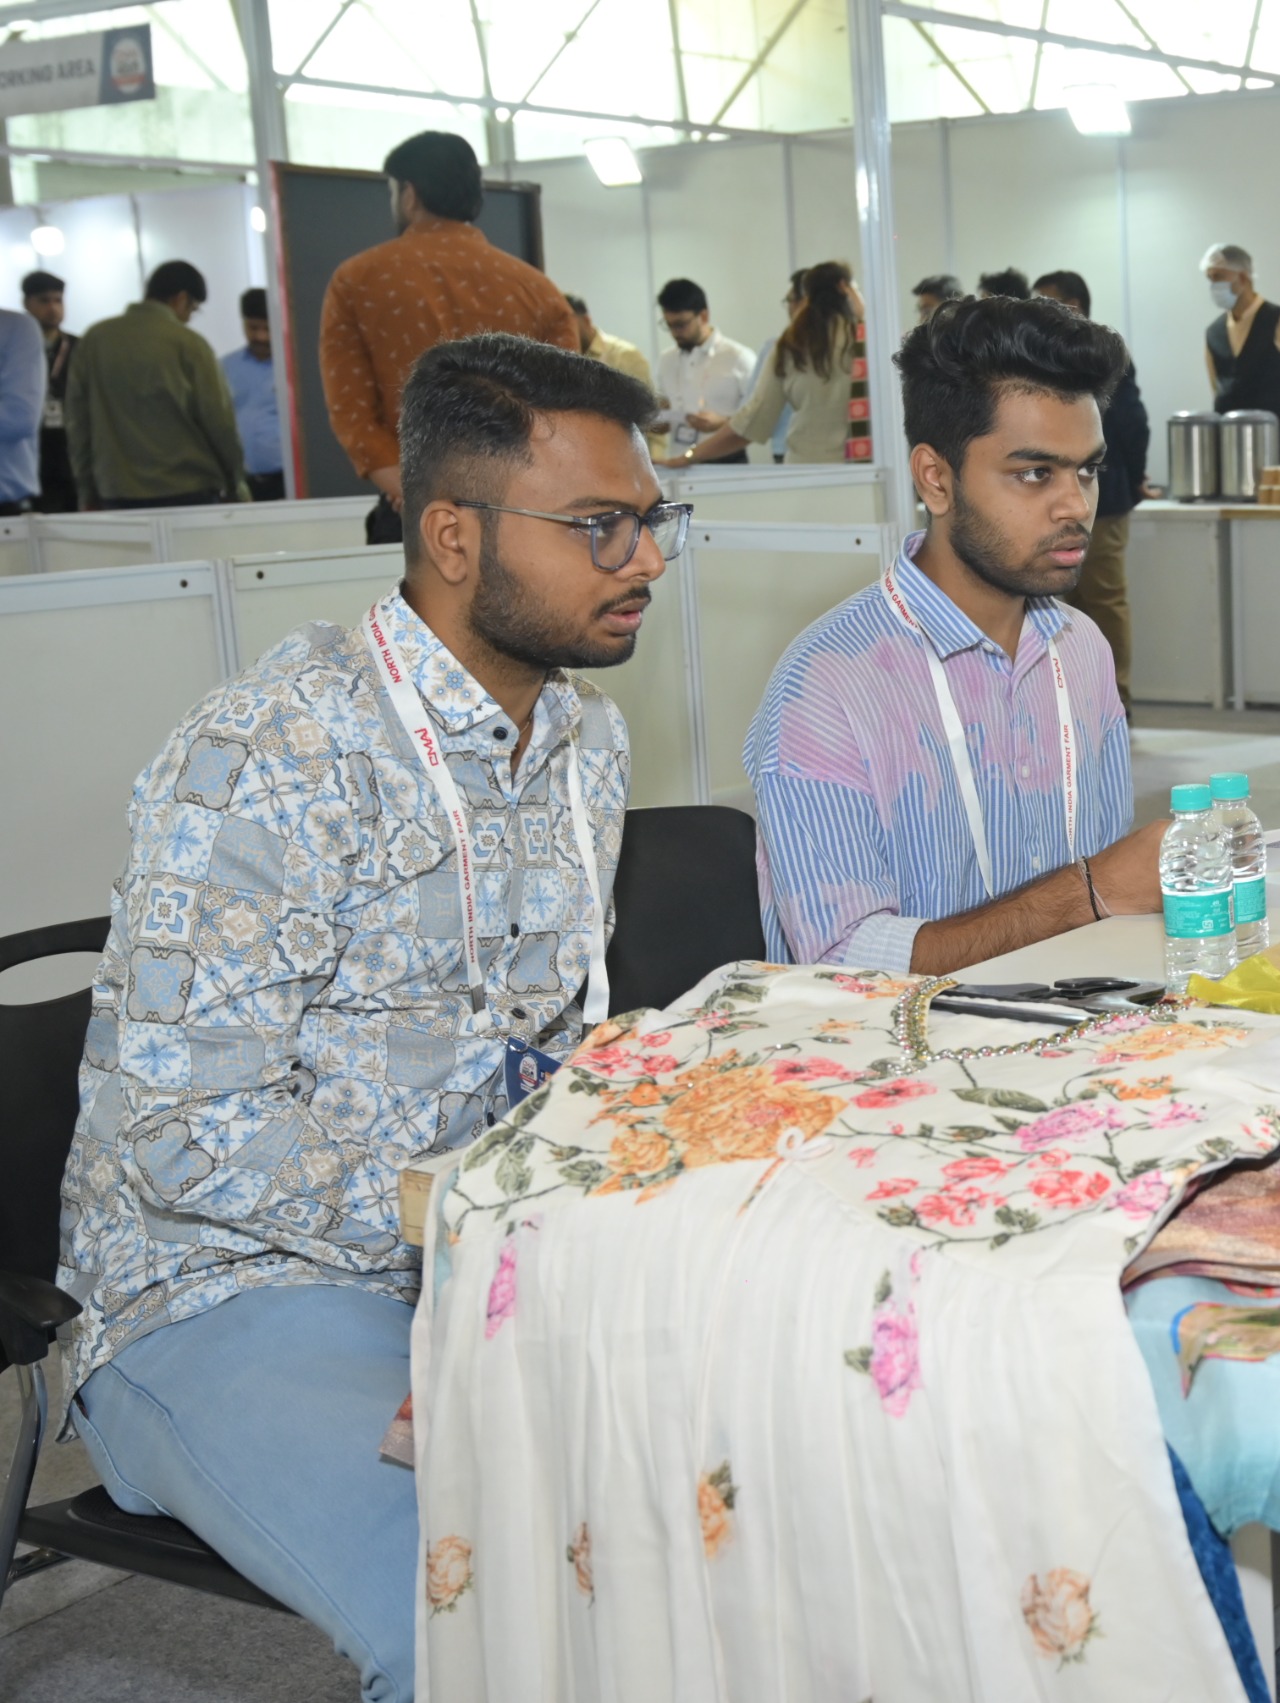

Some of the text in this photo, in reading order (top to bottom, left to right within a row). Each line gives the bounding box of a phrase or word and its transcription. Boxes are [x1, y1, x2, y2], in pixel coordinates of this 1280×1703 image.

[57, 57, 97, 80] AREA
[370, 621, 387, 648] INDIA
[381, 648, 403, 684] NORTH
[414, 727, 439, 767] CMAI
[452, 810, 464, 833] FAIR
[460, 838, 471, 890] GARMENT
[468, 926, 476, 963] NORTH
